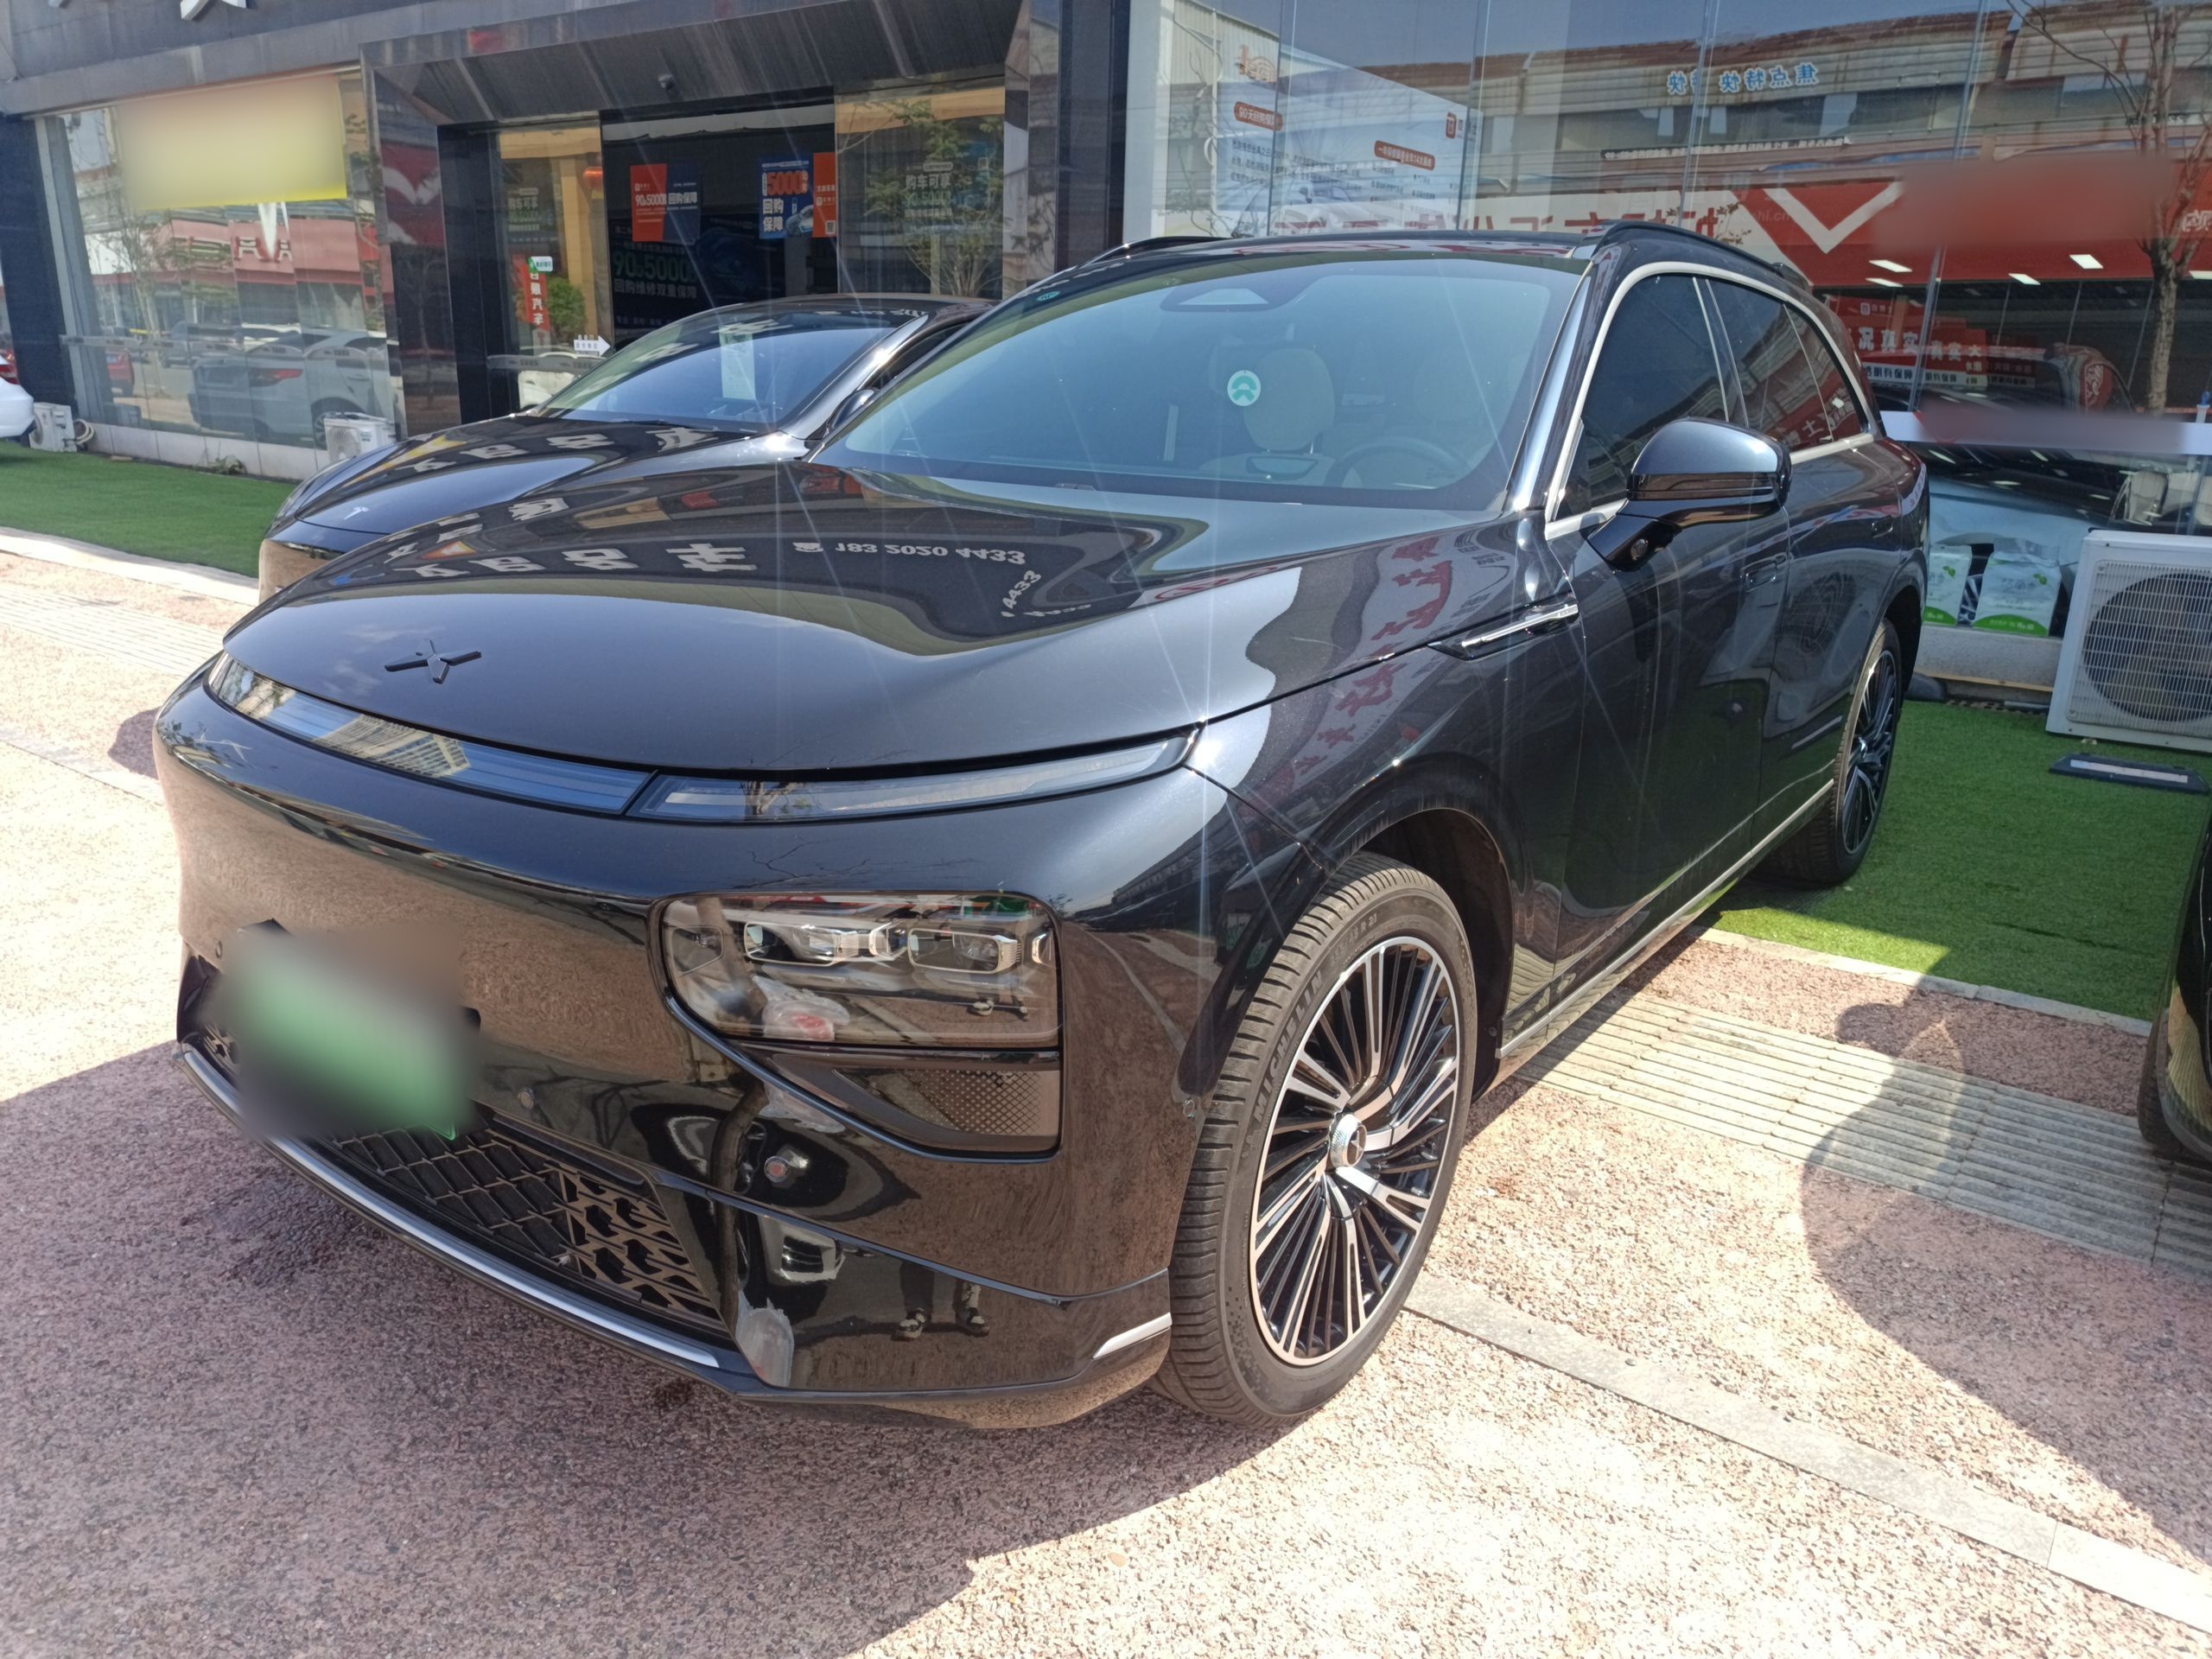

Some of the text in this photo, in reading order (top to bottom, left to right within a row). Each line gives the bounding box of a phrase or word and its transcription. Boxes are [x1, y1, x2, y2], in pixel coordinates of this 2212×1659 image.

[762, 197, 784, 215] 回购
[763, 216, 784, 233] 保障
[1254, 971, 1324, 1123] MICHELIN
